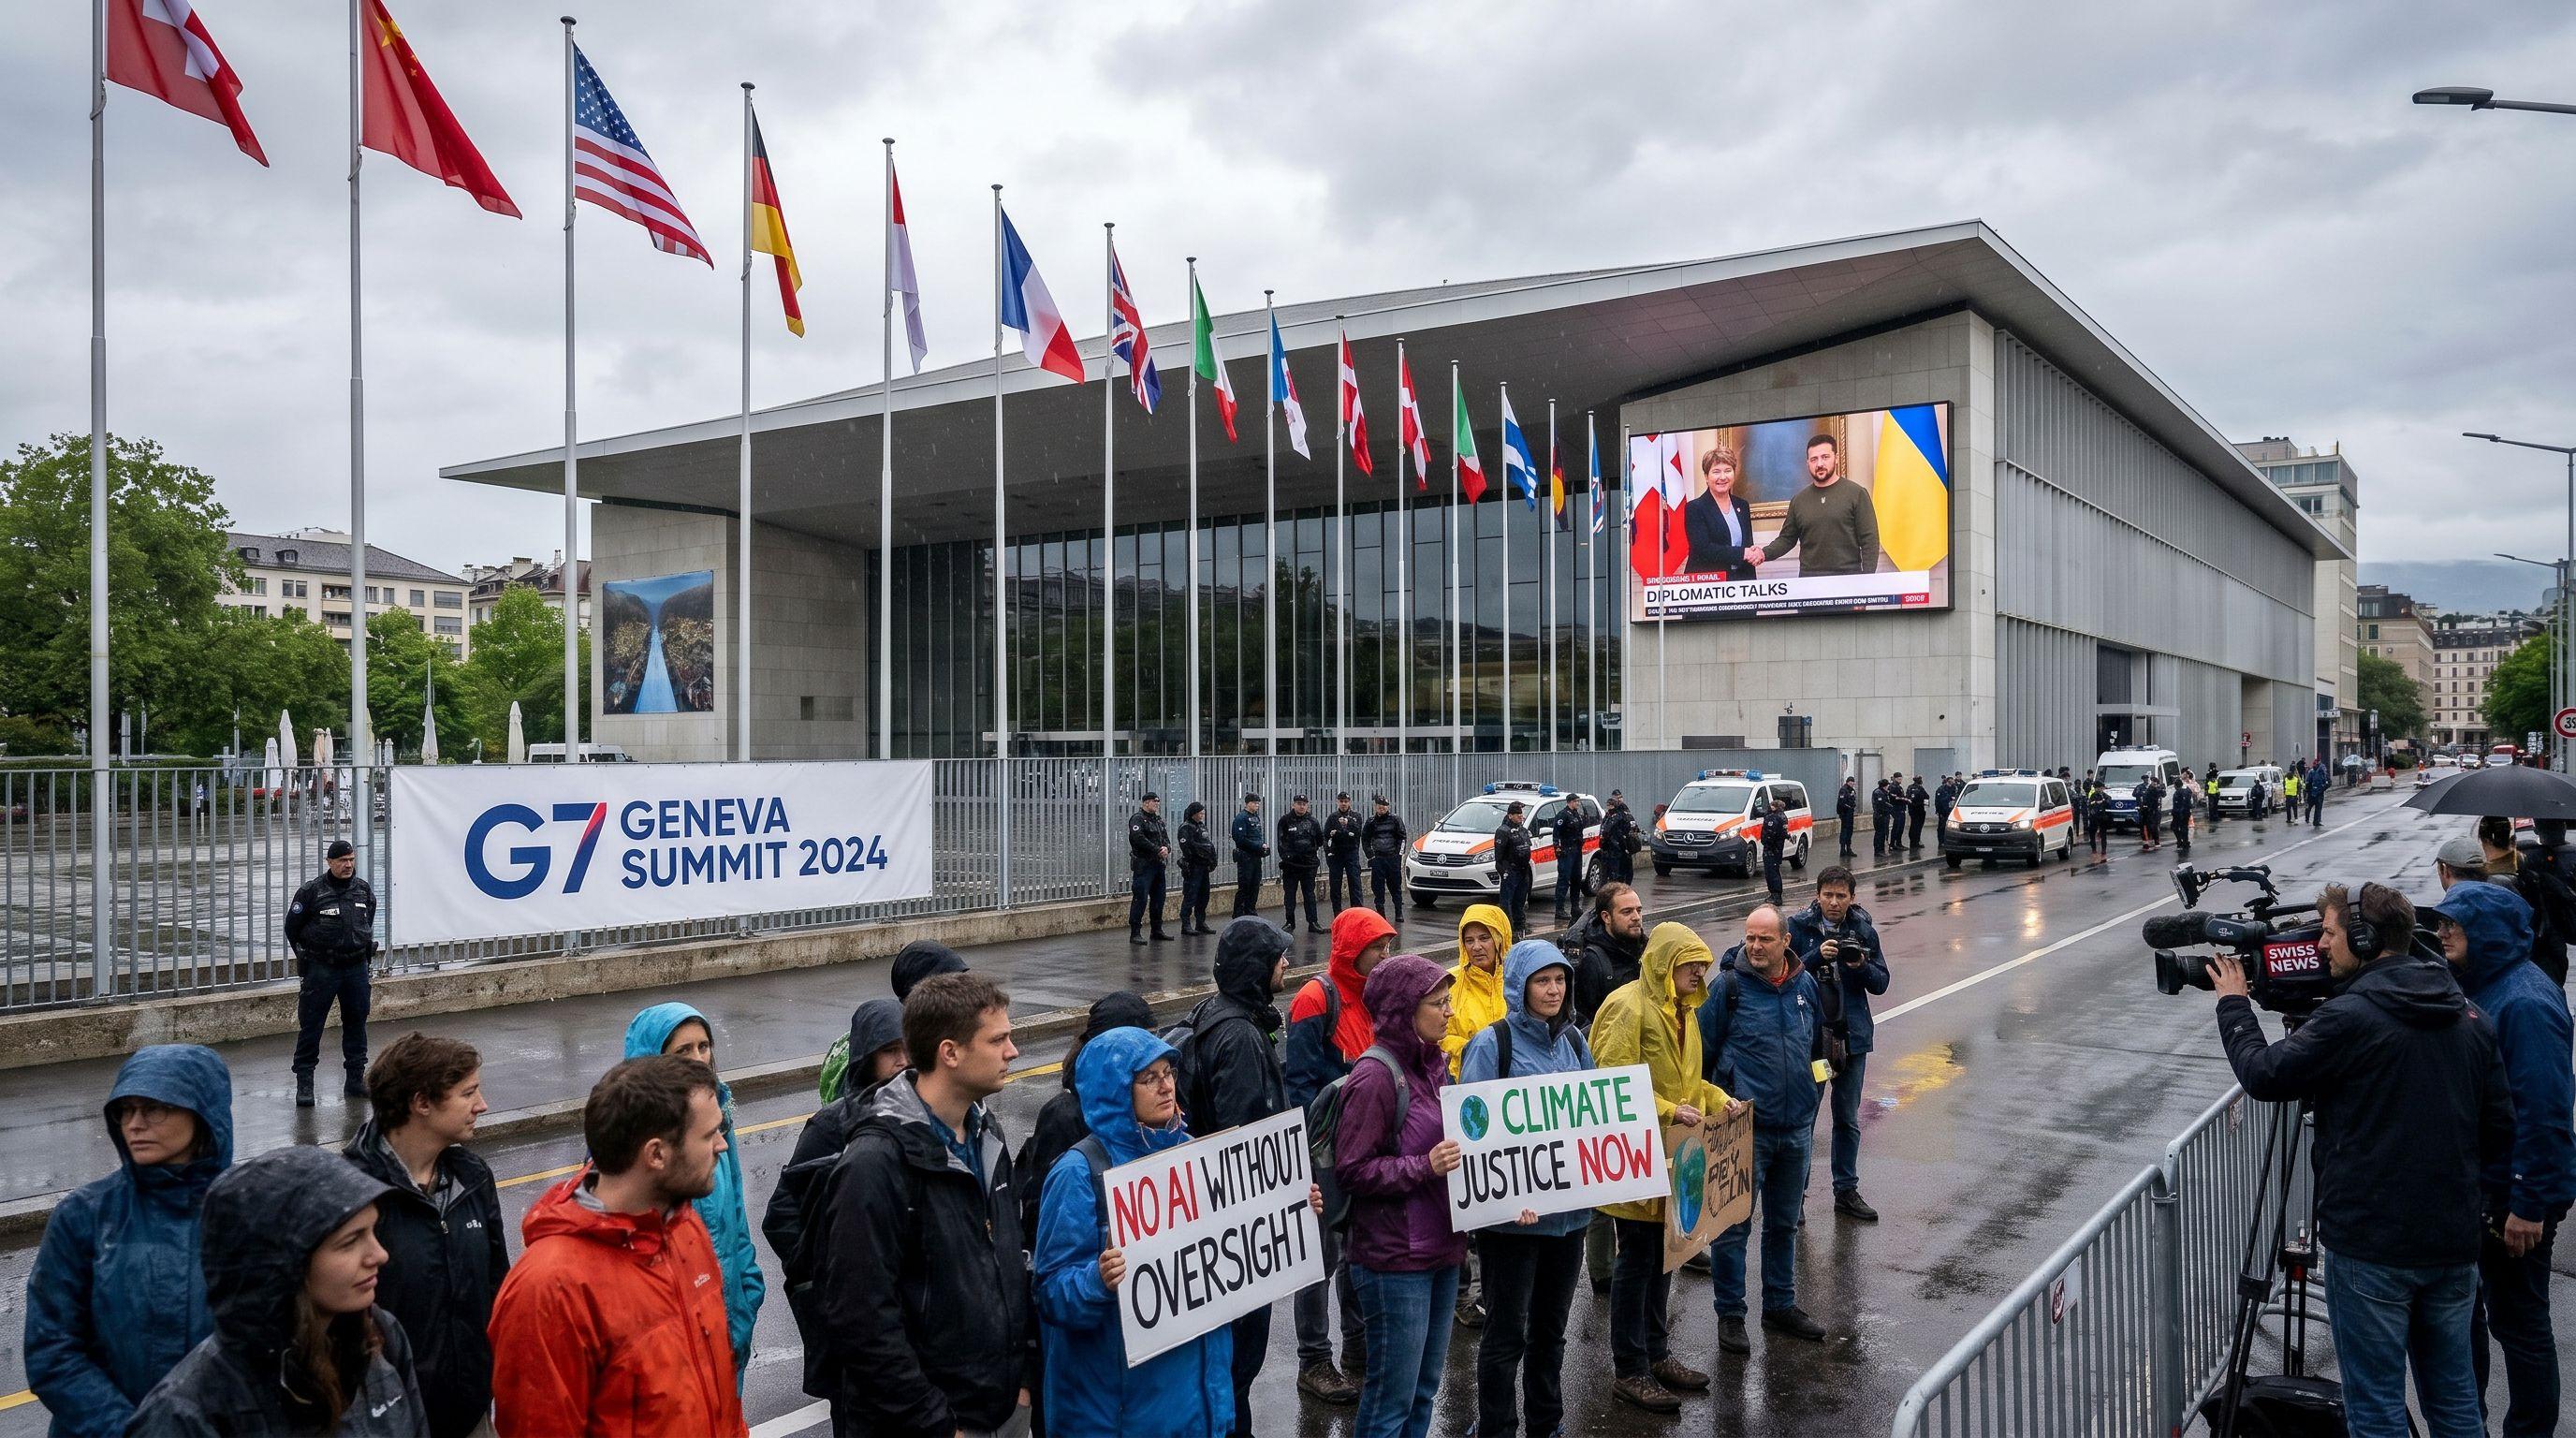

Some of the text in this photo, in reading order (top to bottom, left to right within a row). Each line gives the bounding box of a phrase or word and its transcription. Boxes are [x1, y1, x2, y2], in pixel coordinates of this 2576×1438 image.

[1647, 582, 1788, 602] DIPLOMATIC TALKS
[621, 797, 790, 840] GENEVA
[463, 802, 607, 901] G7
[621, 835, 888, 888] SUMMIT 2024
[2269, 945, 2316, 959] SWISS
[2270, 957, 2320, 973] NEWS
[1501, 1076, 1637, 1137] CLIMATE
[1113, 1124, 1303, 1248] NO AI WITHOUT
[1457, 1139, 1572, 1211] JUSTICE
[1576, 1129, 1652, 1185] NOW
[1132, 1199, 1307, 1329] OVERSIGHT
